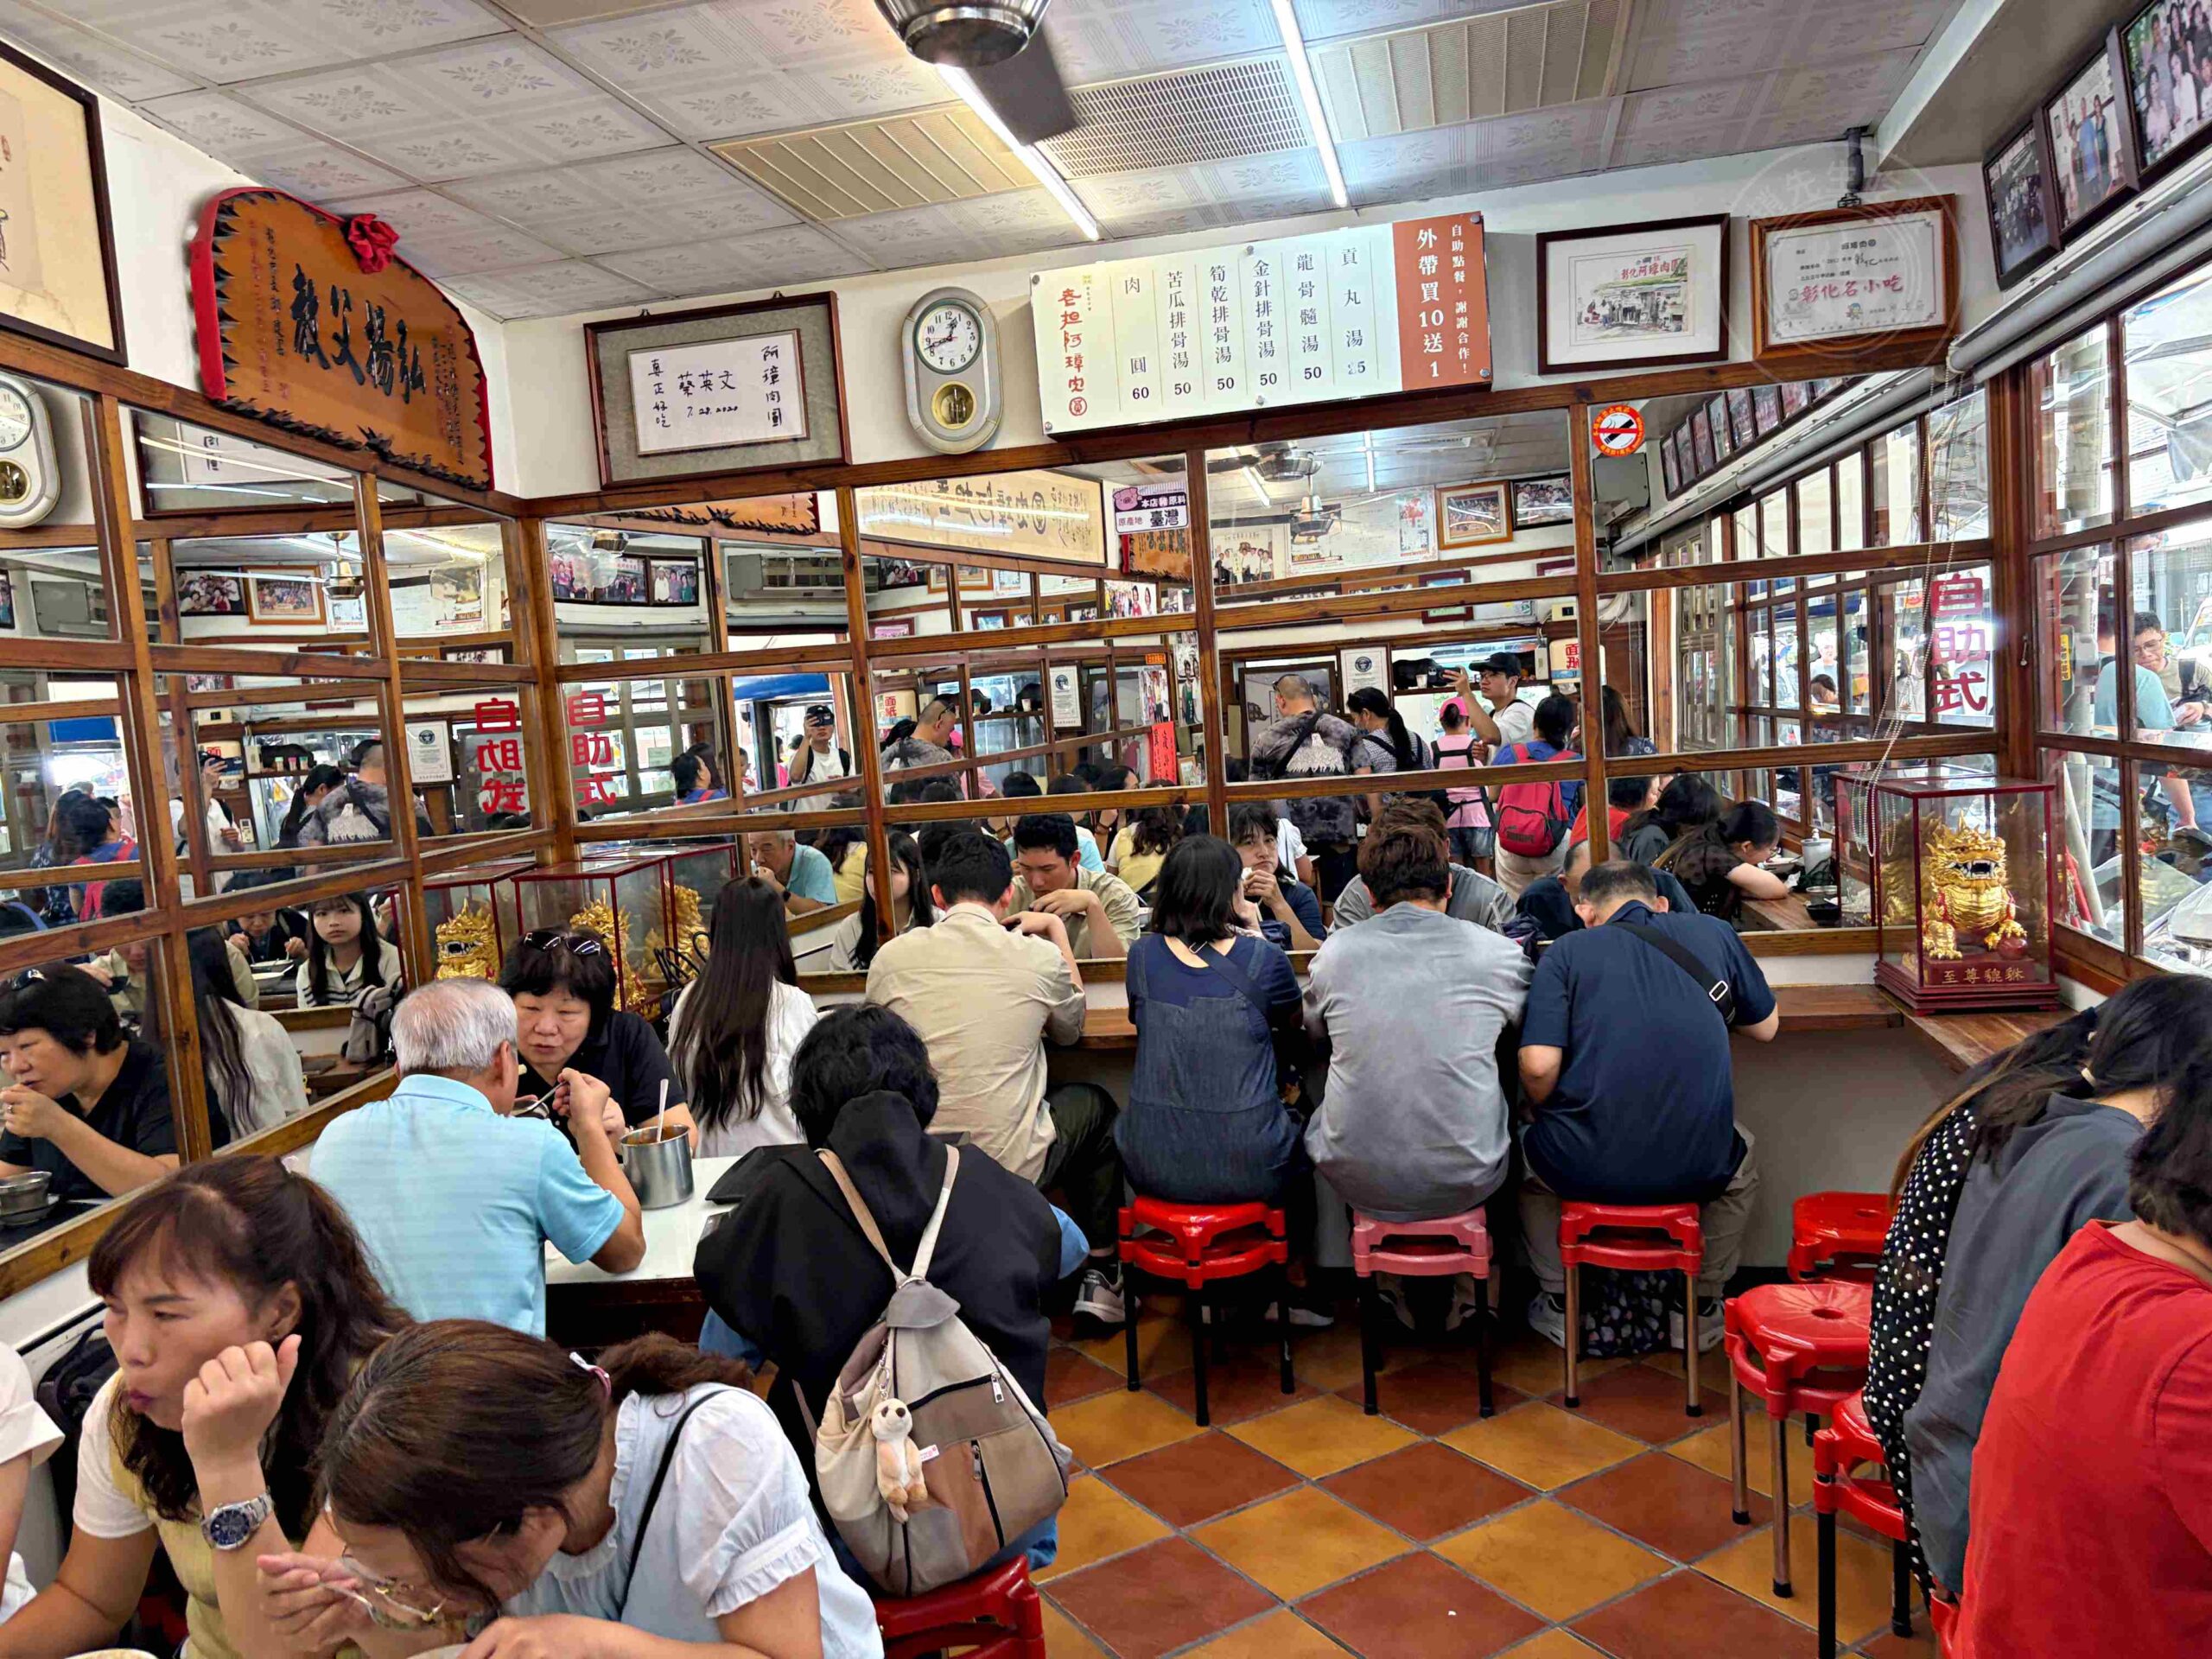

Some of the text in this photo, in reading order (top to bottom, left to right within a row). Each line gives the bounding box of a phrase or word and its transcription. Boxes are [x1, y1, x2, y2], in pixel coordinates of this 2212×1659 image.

[1167, 270, 1189, 369] 苦瓜排骨湯
[1210, 265, 1231, 364] 筍乾排骨湯
[1253, 259, 1274, 359] 金針排骨湯
[1297, 253, 1319, 353] 龍骨髓湯
[1341, 247, 1363, 347] 貢丸湯
[1417, 228, 1444, 378] 外帶買10送1
[1800, 275, 1904, 304] 彰化名小吃
[1125, 276, 1147, 374] 肉圓
[648, 359, 671, 428] 真正好吃
[677, 370, 735, 397] 蔡英文
[1132, 386, 1149, 400] 60
[1174, 382, 1192, 396] 50
[1217, 377, 1235, 391] 50
[1260, 372, 1277, 386] 50
[1304, 366, 1322, 379] 50
[1118, 516, 1143, 526] 原產地
[1150, 509, 1179, 528] 臺灣
[1930, 572, 1987, 715] 自助式
[568, 691, 618, 806] 自助式
